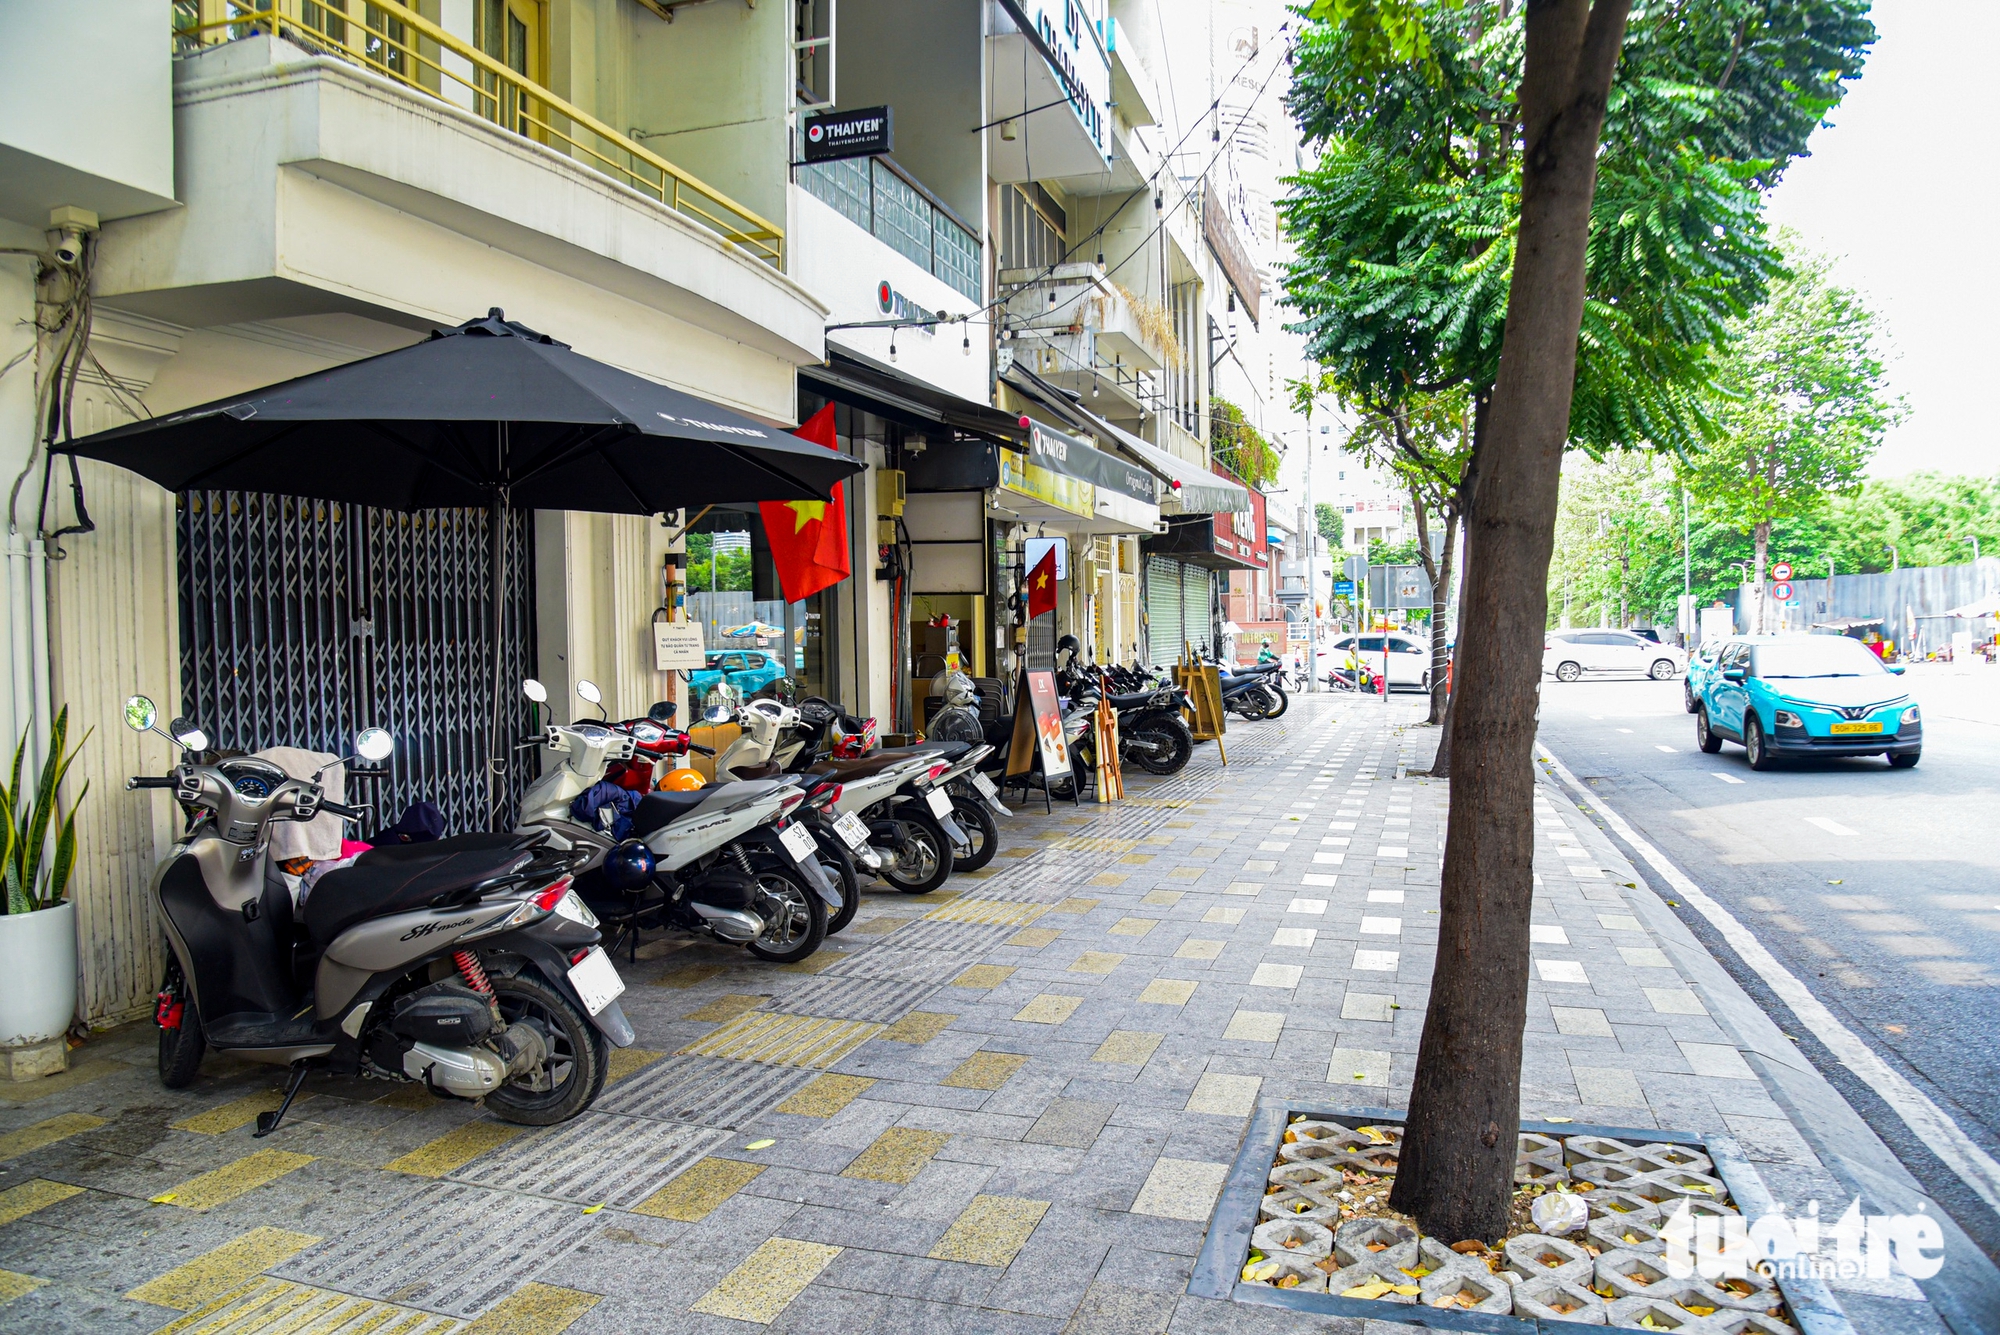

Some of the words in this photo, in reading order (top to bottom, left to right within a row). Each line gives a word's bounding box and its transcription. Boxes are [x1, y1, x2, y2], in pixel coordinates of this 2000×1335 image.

[825, 117, 879, 139] THAIYEN
[1041, 434, 1067, 461] THAIYEN
[400, 921, 441, 942] SH
[437, 917, 474, 932] mode
